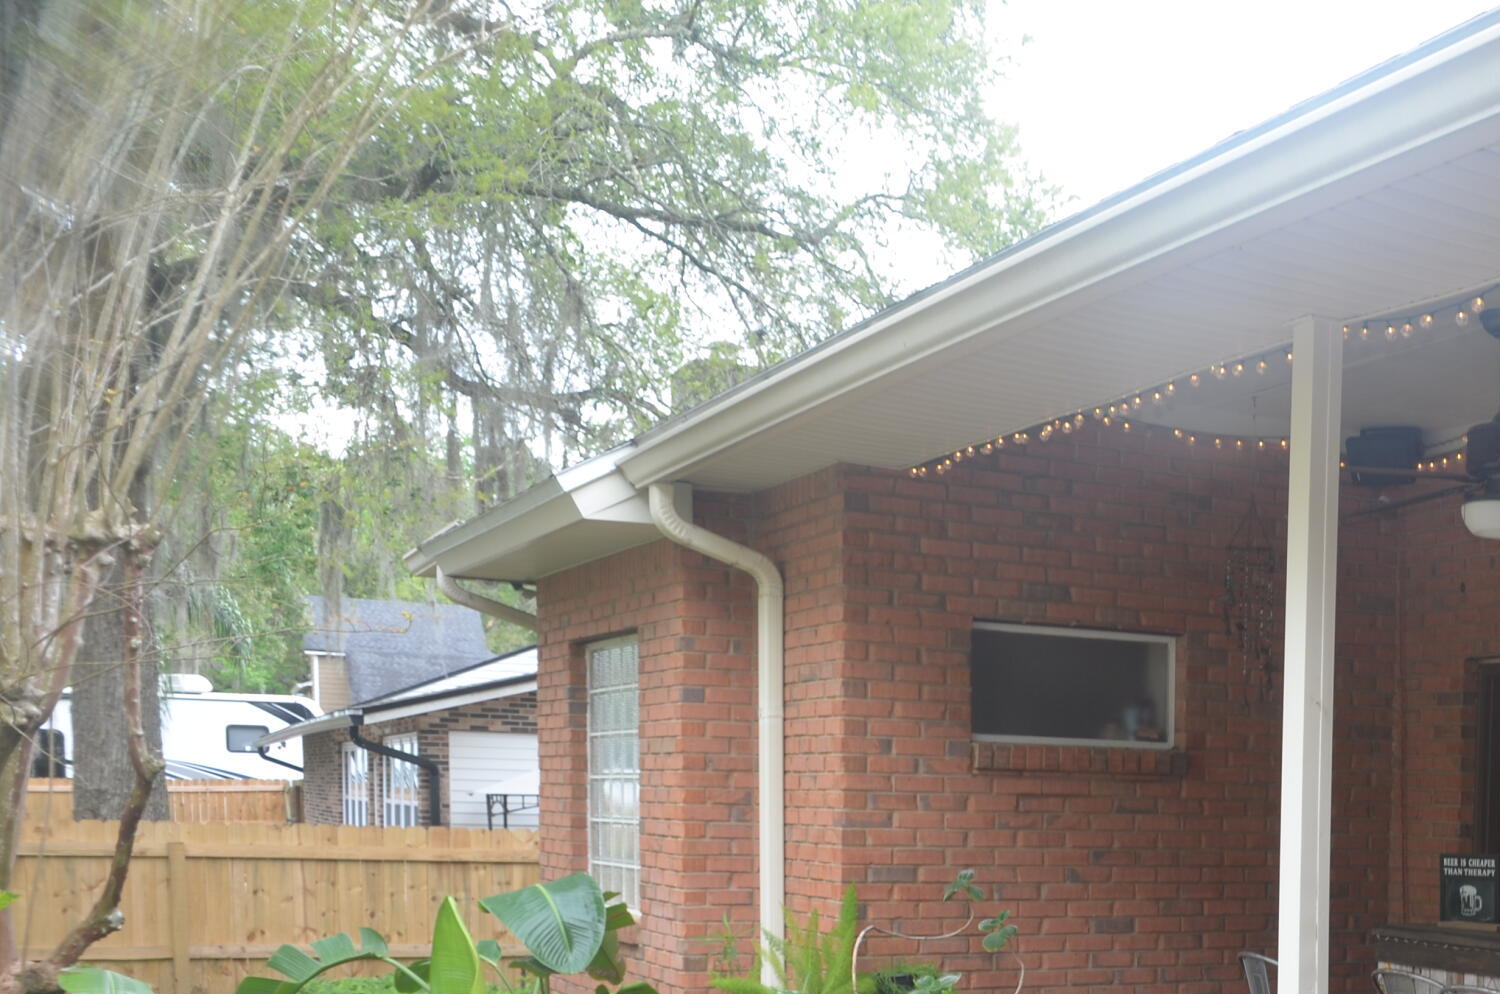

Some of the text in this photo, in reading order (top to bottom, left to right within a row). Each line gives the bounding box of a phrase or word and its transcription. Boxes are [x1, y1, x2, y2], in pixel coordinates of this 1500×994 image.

[1443, 857, 1496, 868] BEER IS CHEAPER
[1443, 867, 1496, 878] THAN THERAPY
